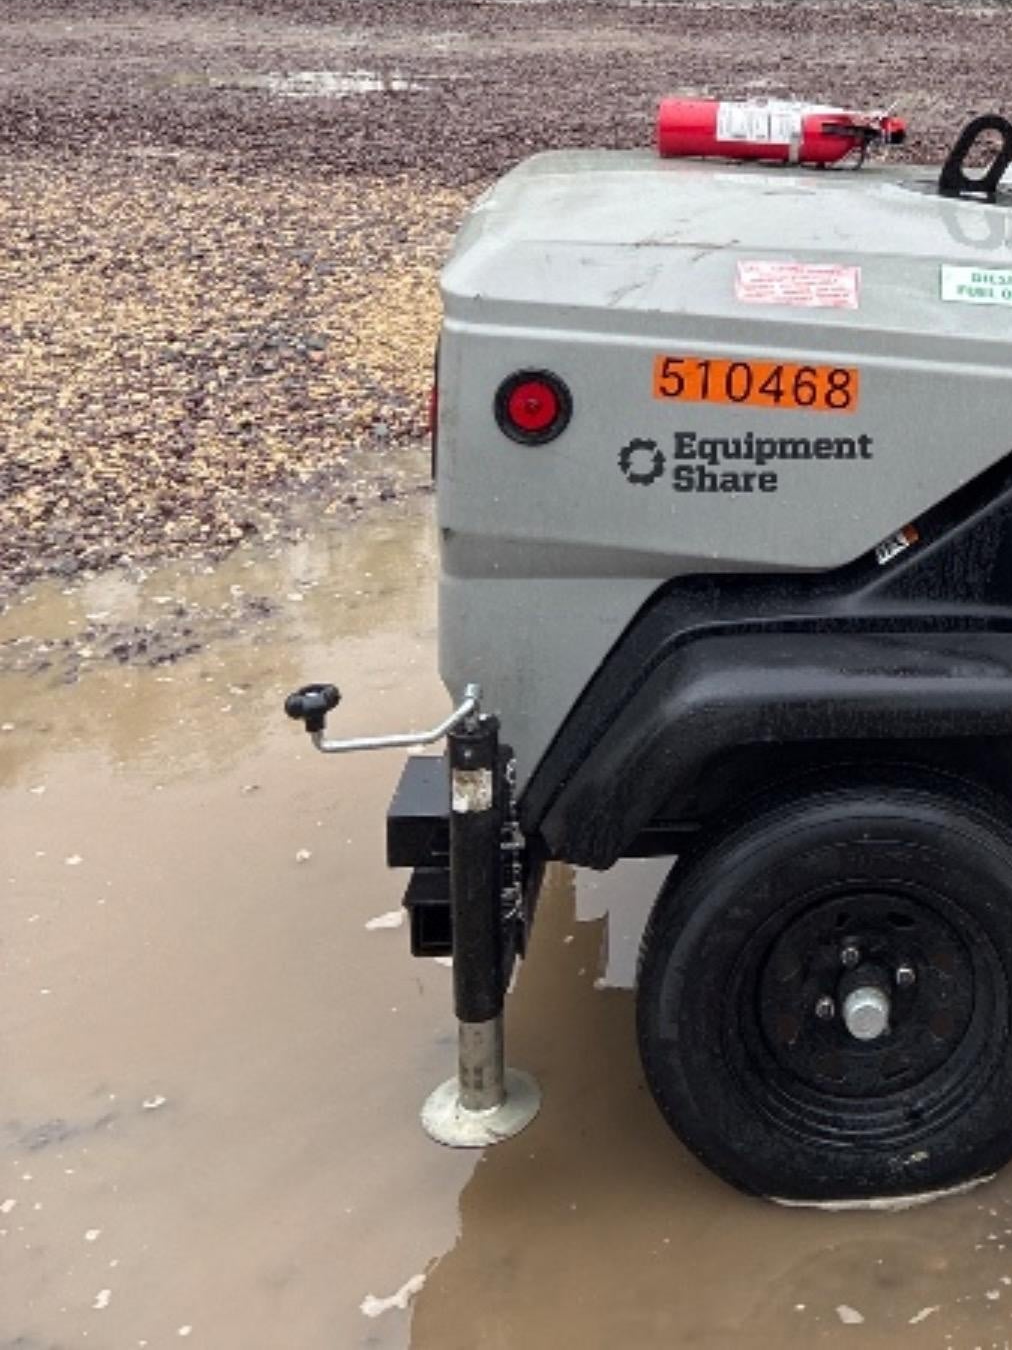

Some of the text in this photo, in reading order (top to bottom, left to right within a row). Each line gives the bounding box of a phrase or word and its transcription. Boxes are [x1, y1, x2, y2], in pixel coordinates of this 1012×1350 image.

[658, 357, 852, 409] 510468
[673, 431, 874, 466] Equipment
[672, 464, 778, 493] Share
